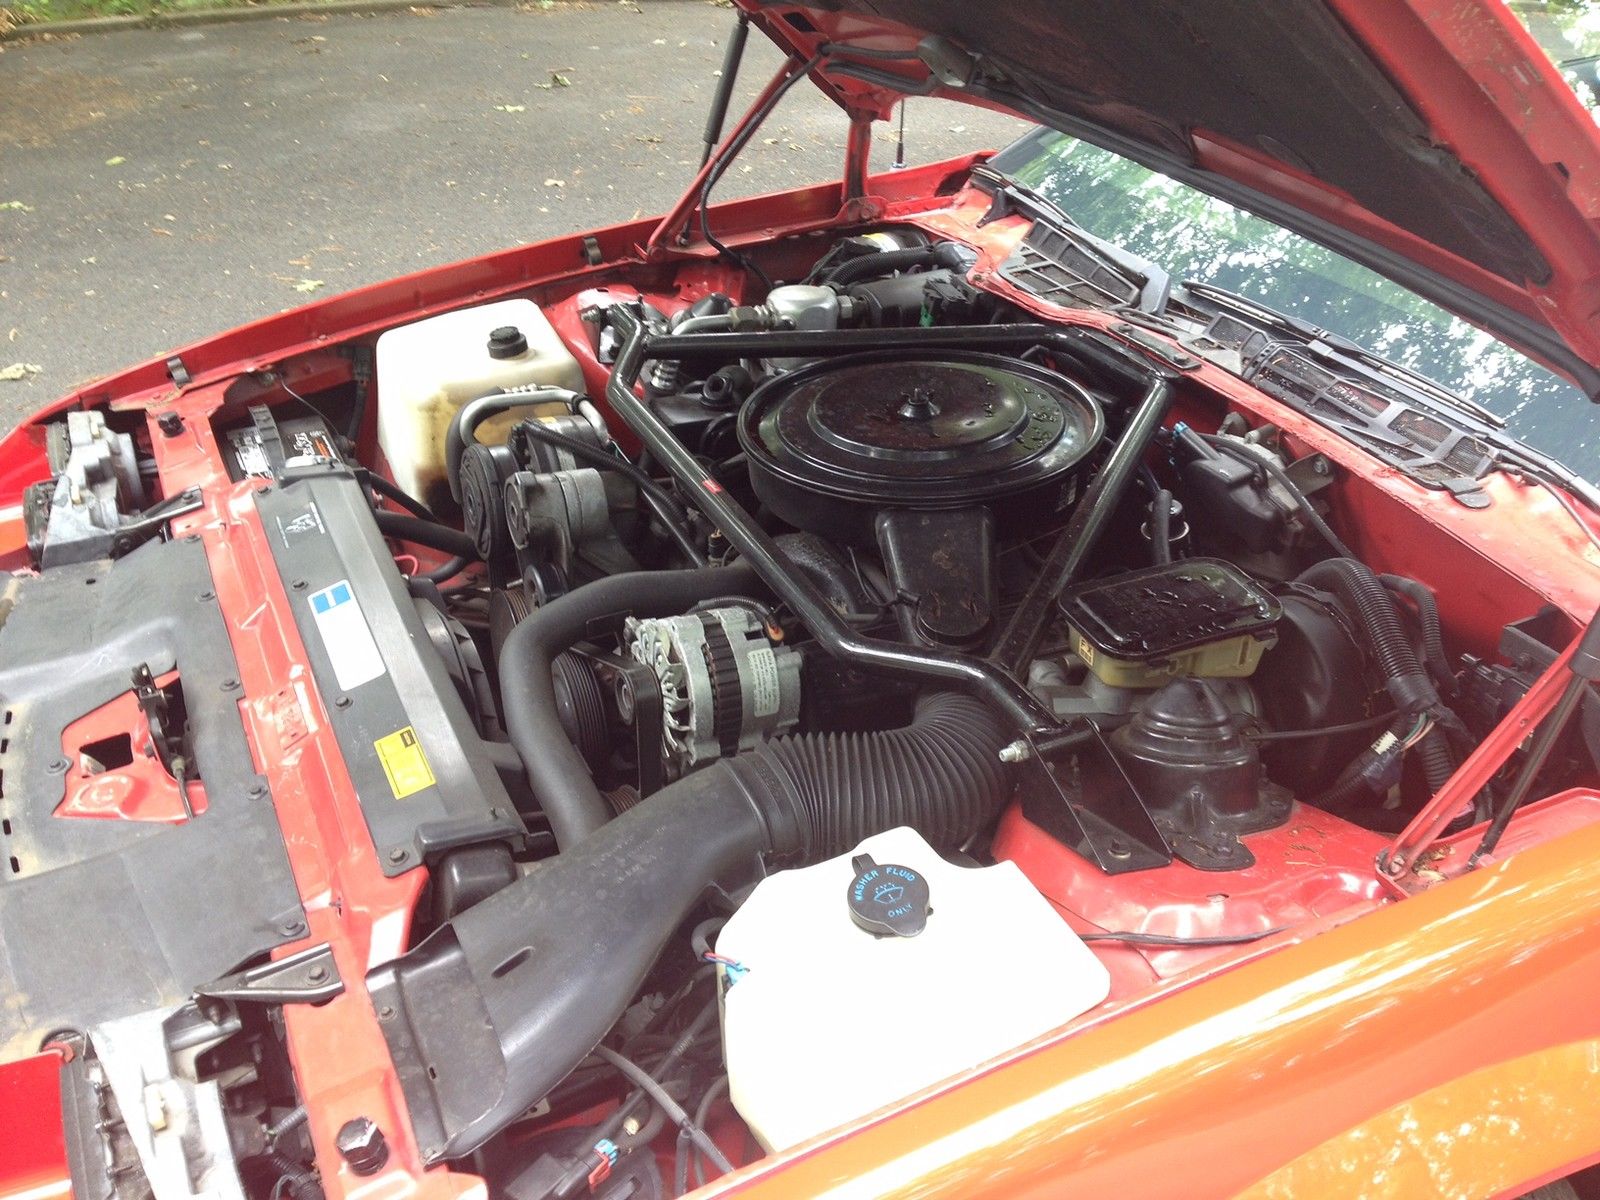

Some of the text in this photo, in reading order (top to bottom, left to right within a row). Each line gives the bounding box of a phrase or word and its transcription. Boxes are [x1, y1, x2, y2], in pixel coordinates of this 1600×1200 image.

[854, 867, 915, 901] WASHER FLUID
[888, 903, 913, 918] ONLY
